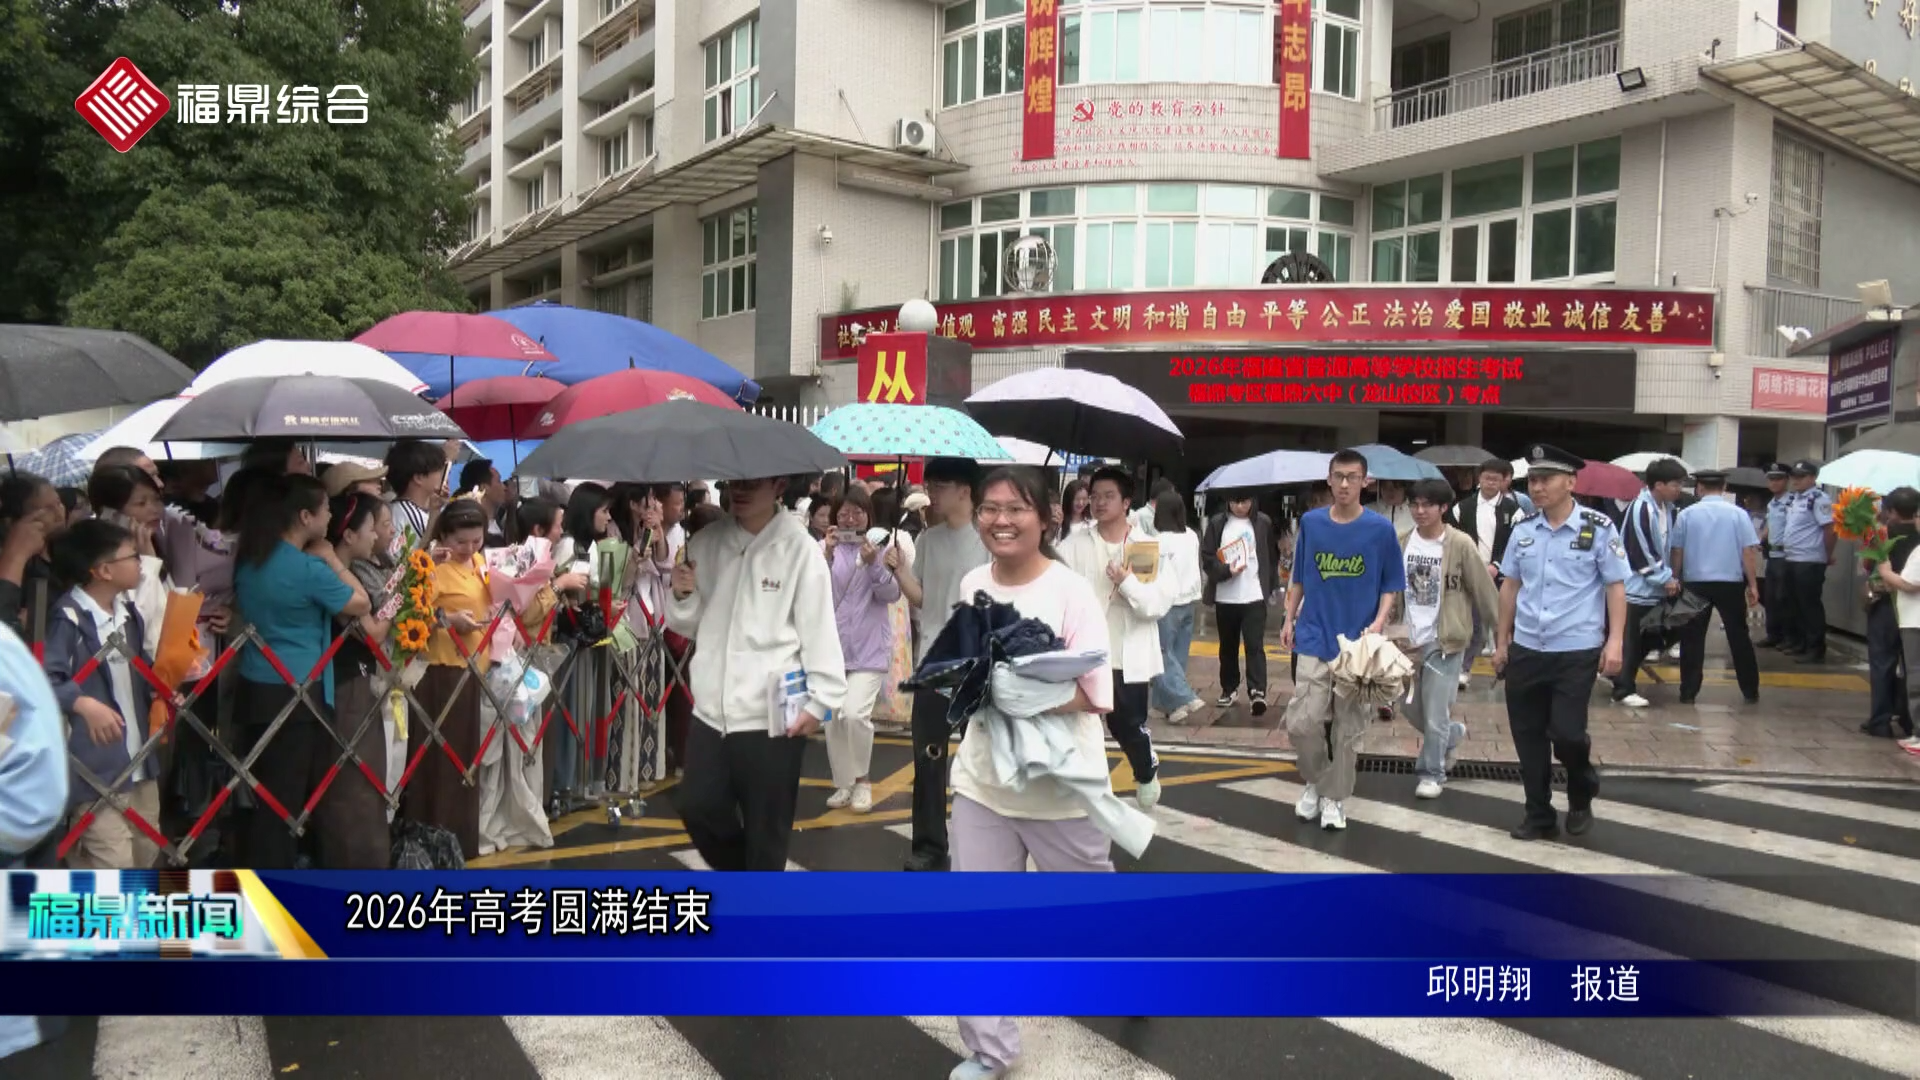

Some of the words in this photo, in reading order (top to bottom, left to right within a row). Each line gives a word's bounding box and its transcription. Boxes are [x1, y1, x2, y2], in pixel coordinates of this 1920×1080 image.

[1108, 101, 1226, 119] 党的教育方针
[992, 308, 1028, 338] 富强
[1038, 306, 1079, 334] 民主
[1091, 303, 1132, 331] 文明
[1143, 301, 1190, 330] 和谐
[1202, 301, 1246, 330] 自由
[1260, 298, 1309, 331] 平等
[1320, 299, 1371, 328] 公正
[1383, 299, 1434, 328] 法治
[1443, 298, 1491, 329] 爱国
[1503, 299, 1552, 329] 敬业
[1562, 299, 1612, 330] 诚信
[1619, 301, 1667, 333] 友善
[867, 351, 915, 403] 从
[1169, 355, 1524, 380] 2026年福建省普通高等学校招生考试
